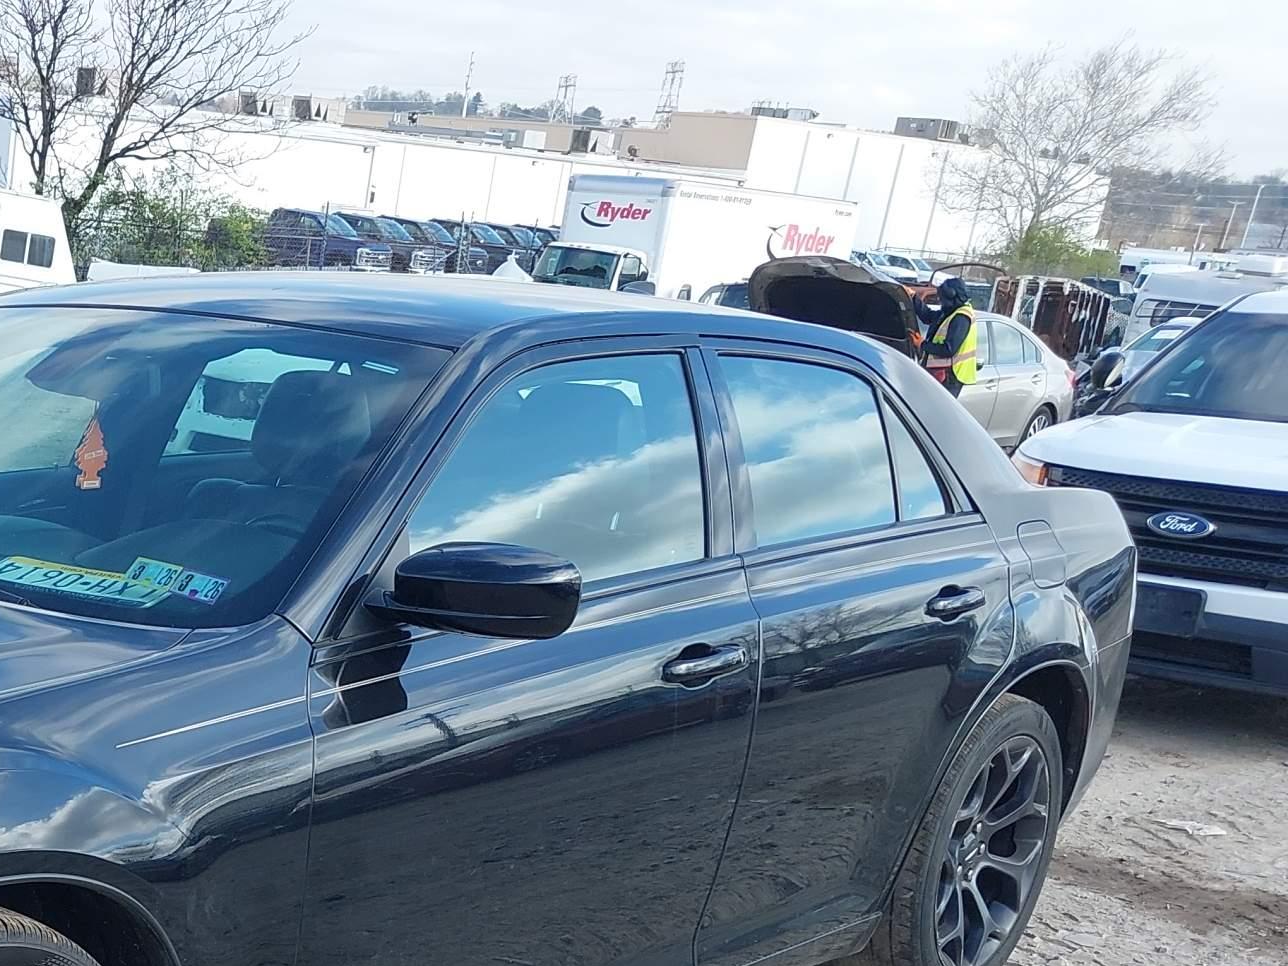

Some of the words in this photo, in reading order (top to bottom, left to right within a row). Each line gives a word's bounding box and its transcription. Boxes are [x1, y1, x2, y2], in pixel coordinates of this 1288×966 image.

[595, 200, 652, 222] Ryder
[781, 223, 835, 256] Ryder
[1159, 515, 1199, 533] Ford
